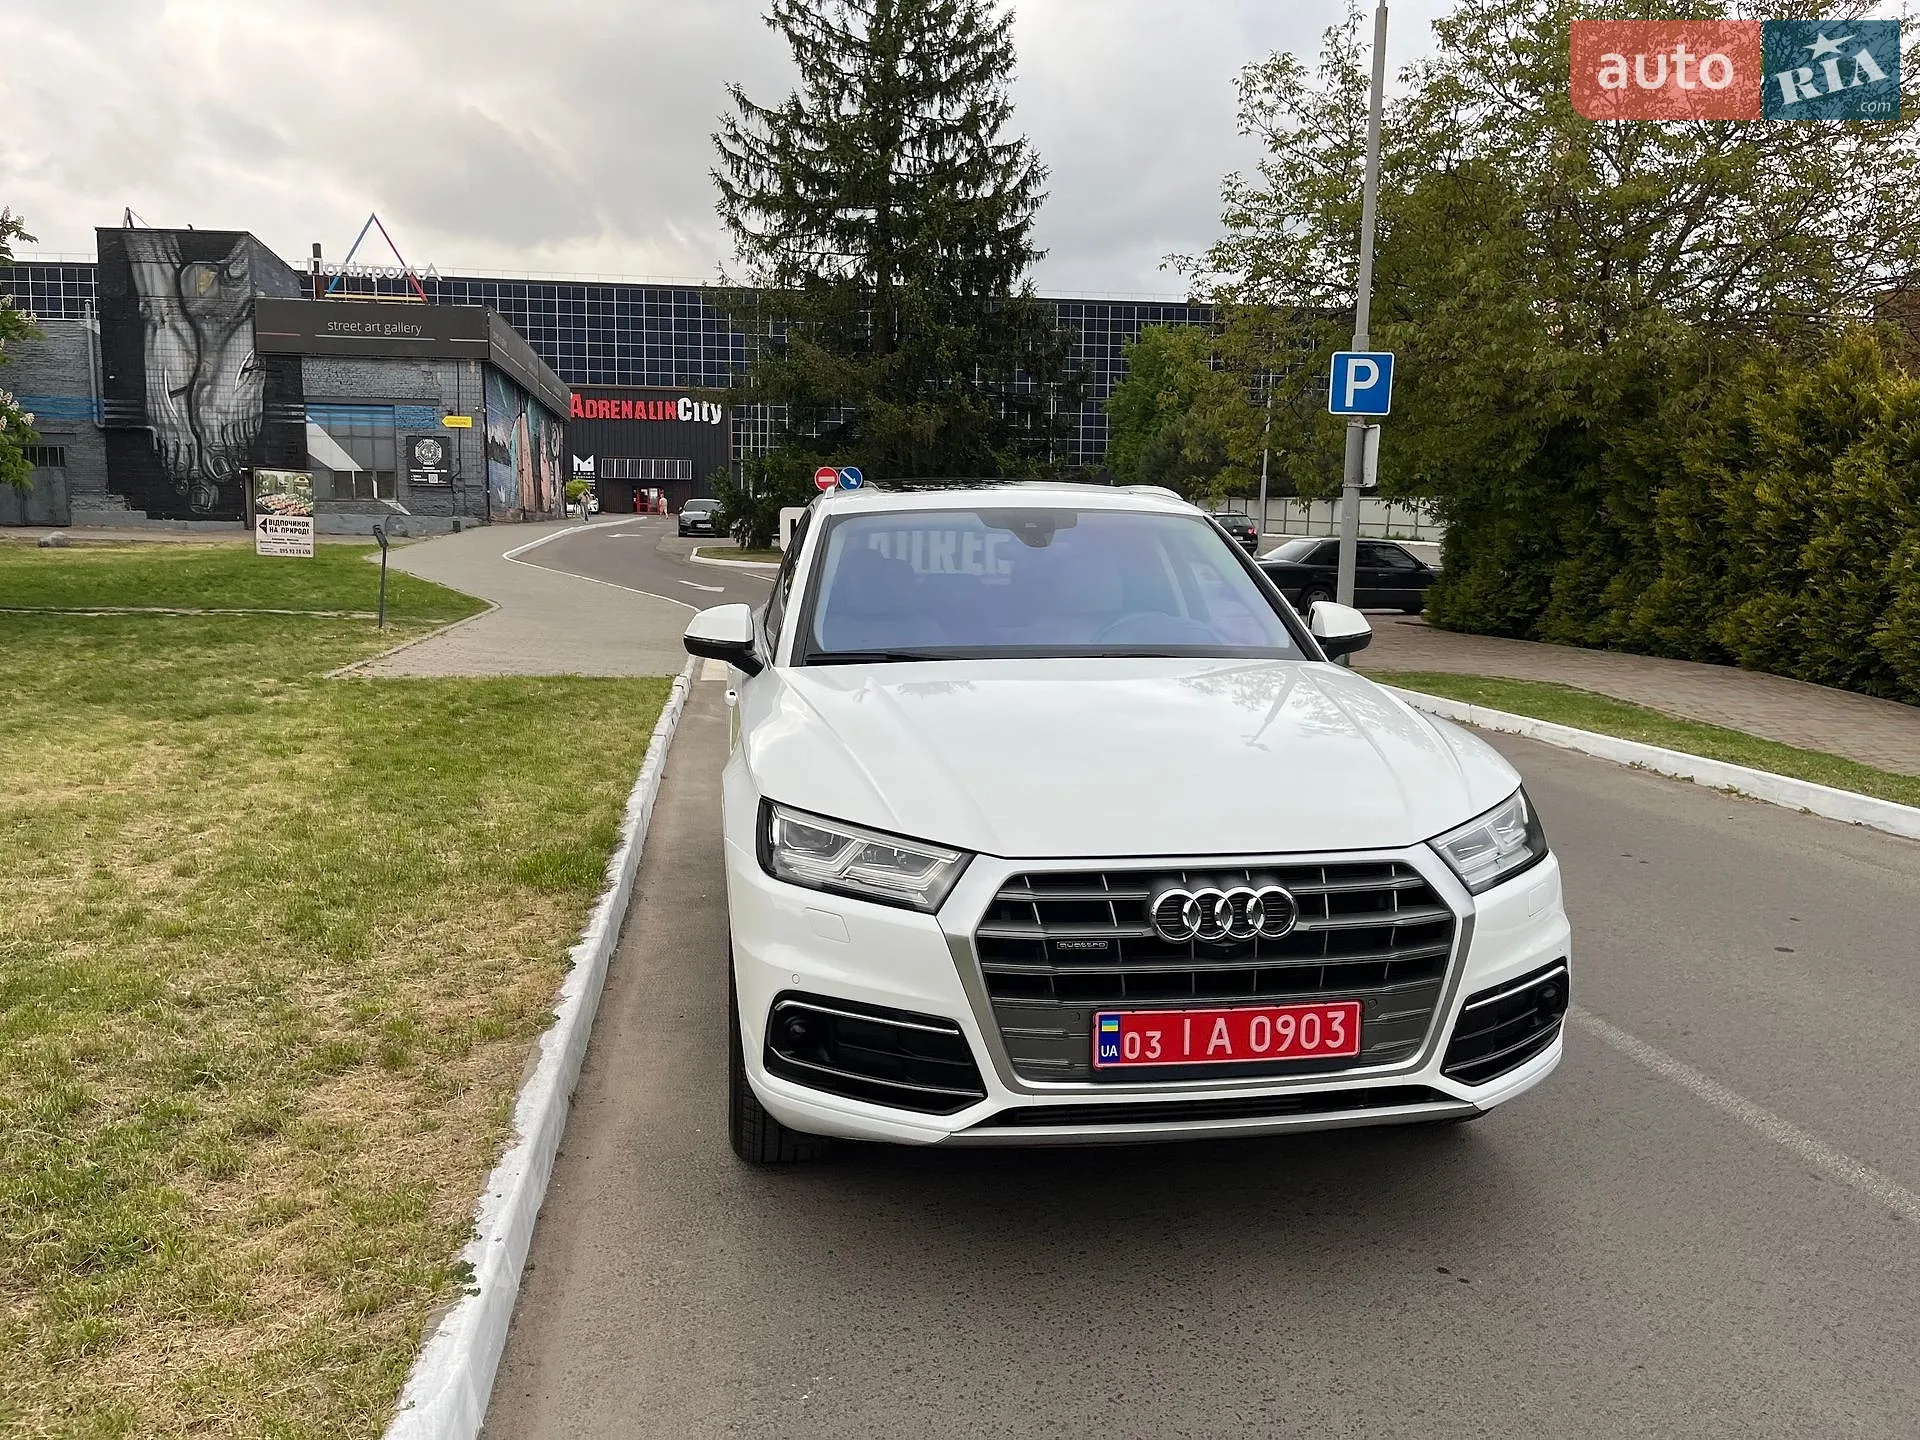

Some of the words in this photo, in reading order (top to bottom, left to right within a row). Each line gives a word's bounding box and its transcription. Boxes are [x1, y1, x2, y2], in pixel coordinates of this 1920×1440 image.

[327, 321, 361, 332] street
[364, 322, 381, 333] art
[384, 322, 422, 336] gallery
[1344, 358, 1380, 408] P
[280, 527, 310, 535] ПРИРОДІ
[1100, 1045, 1118, 1057] UA
[1123, 1031, 1162, 1060] 03
[1249, 1010, 1346, 1053] 0903
